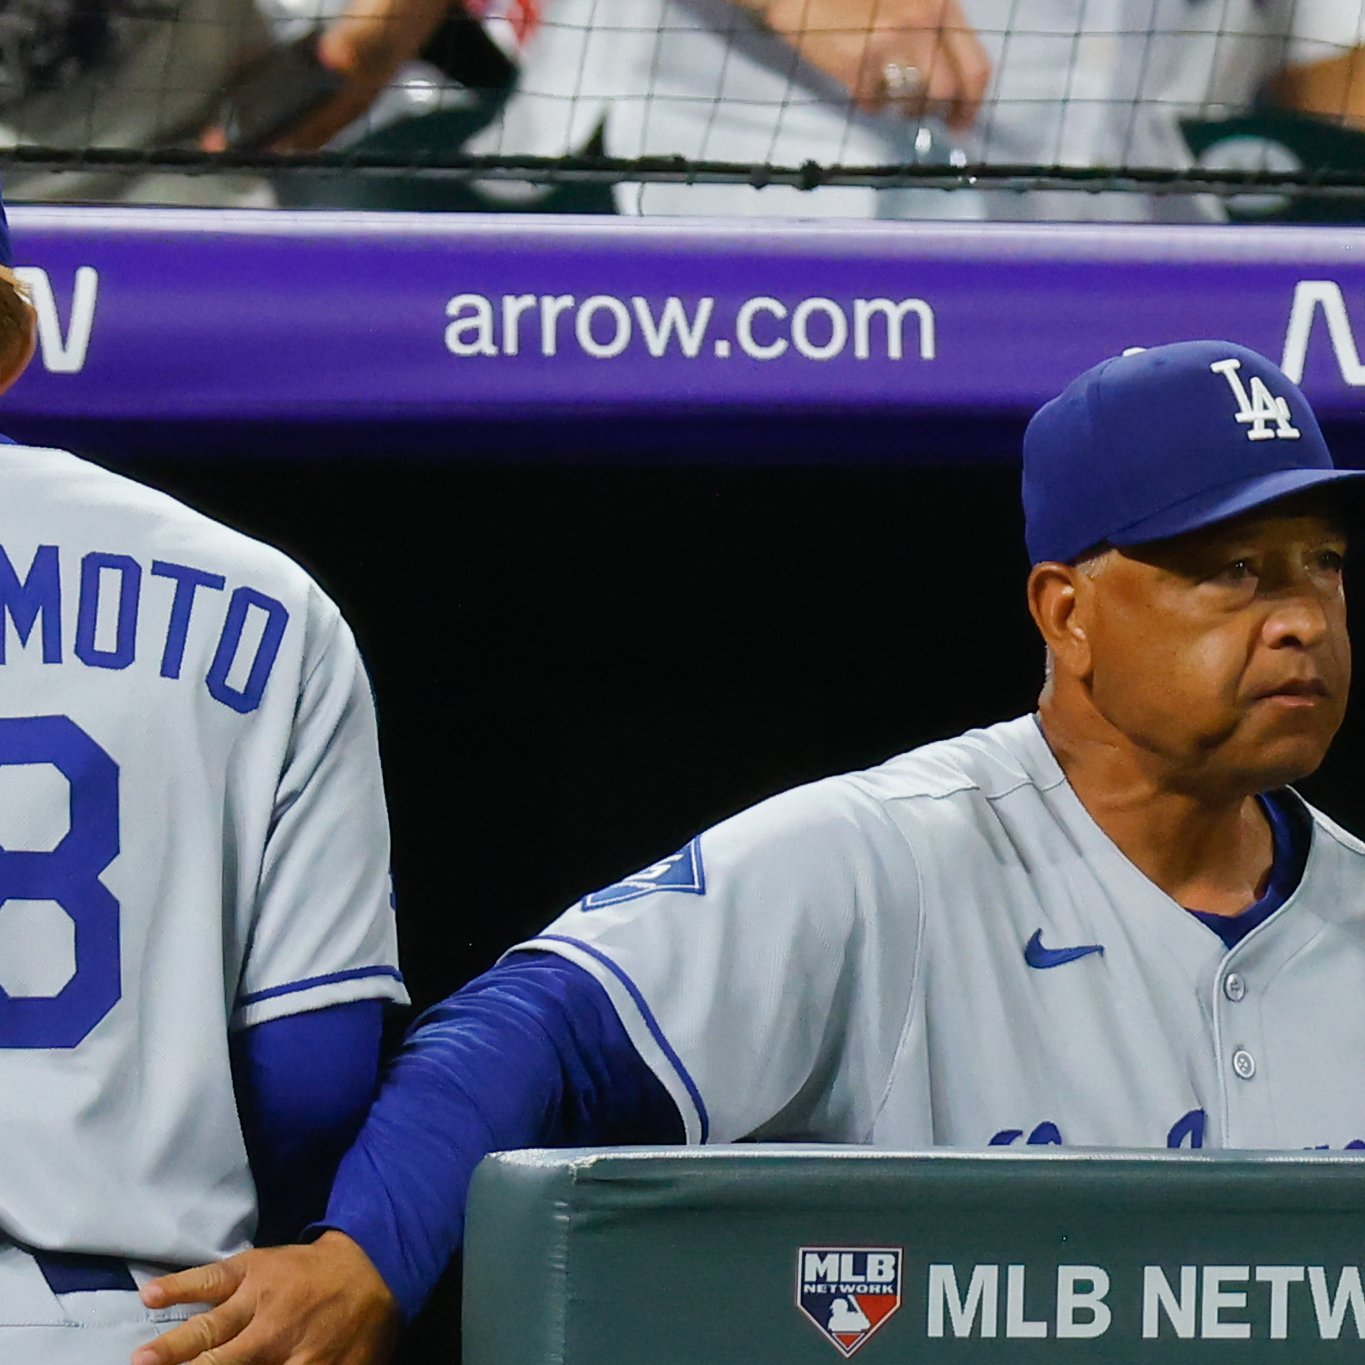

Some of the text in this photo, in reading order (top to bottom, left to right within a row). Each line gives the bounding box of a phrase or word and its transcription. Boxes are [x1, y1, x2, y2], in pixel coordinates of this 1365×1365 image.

[445, 294, 935, 360] arrow.com
[1210, 358, 1301, 442] LA
[803, 1284, 894, 1294] NETWORK
[804, 1253, 895, 1282] MLB
[927, 1264, 1111, 1338] MLB
